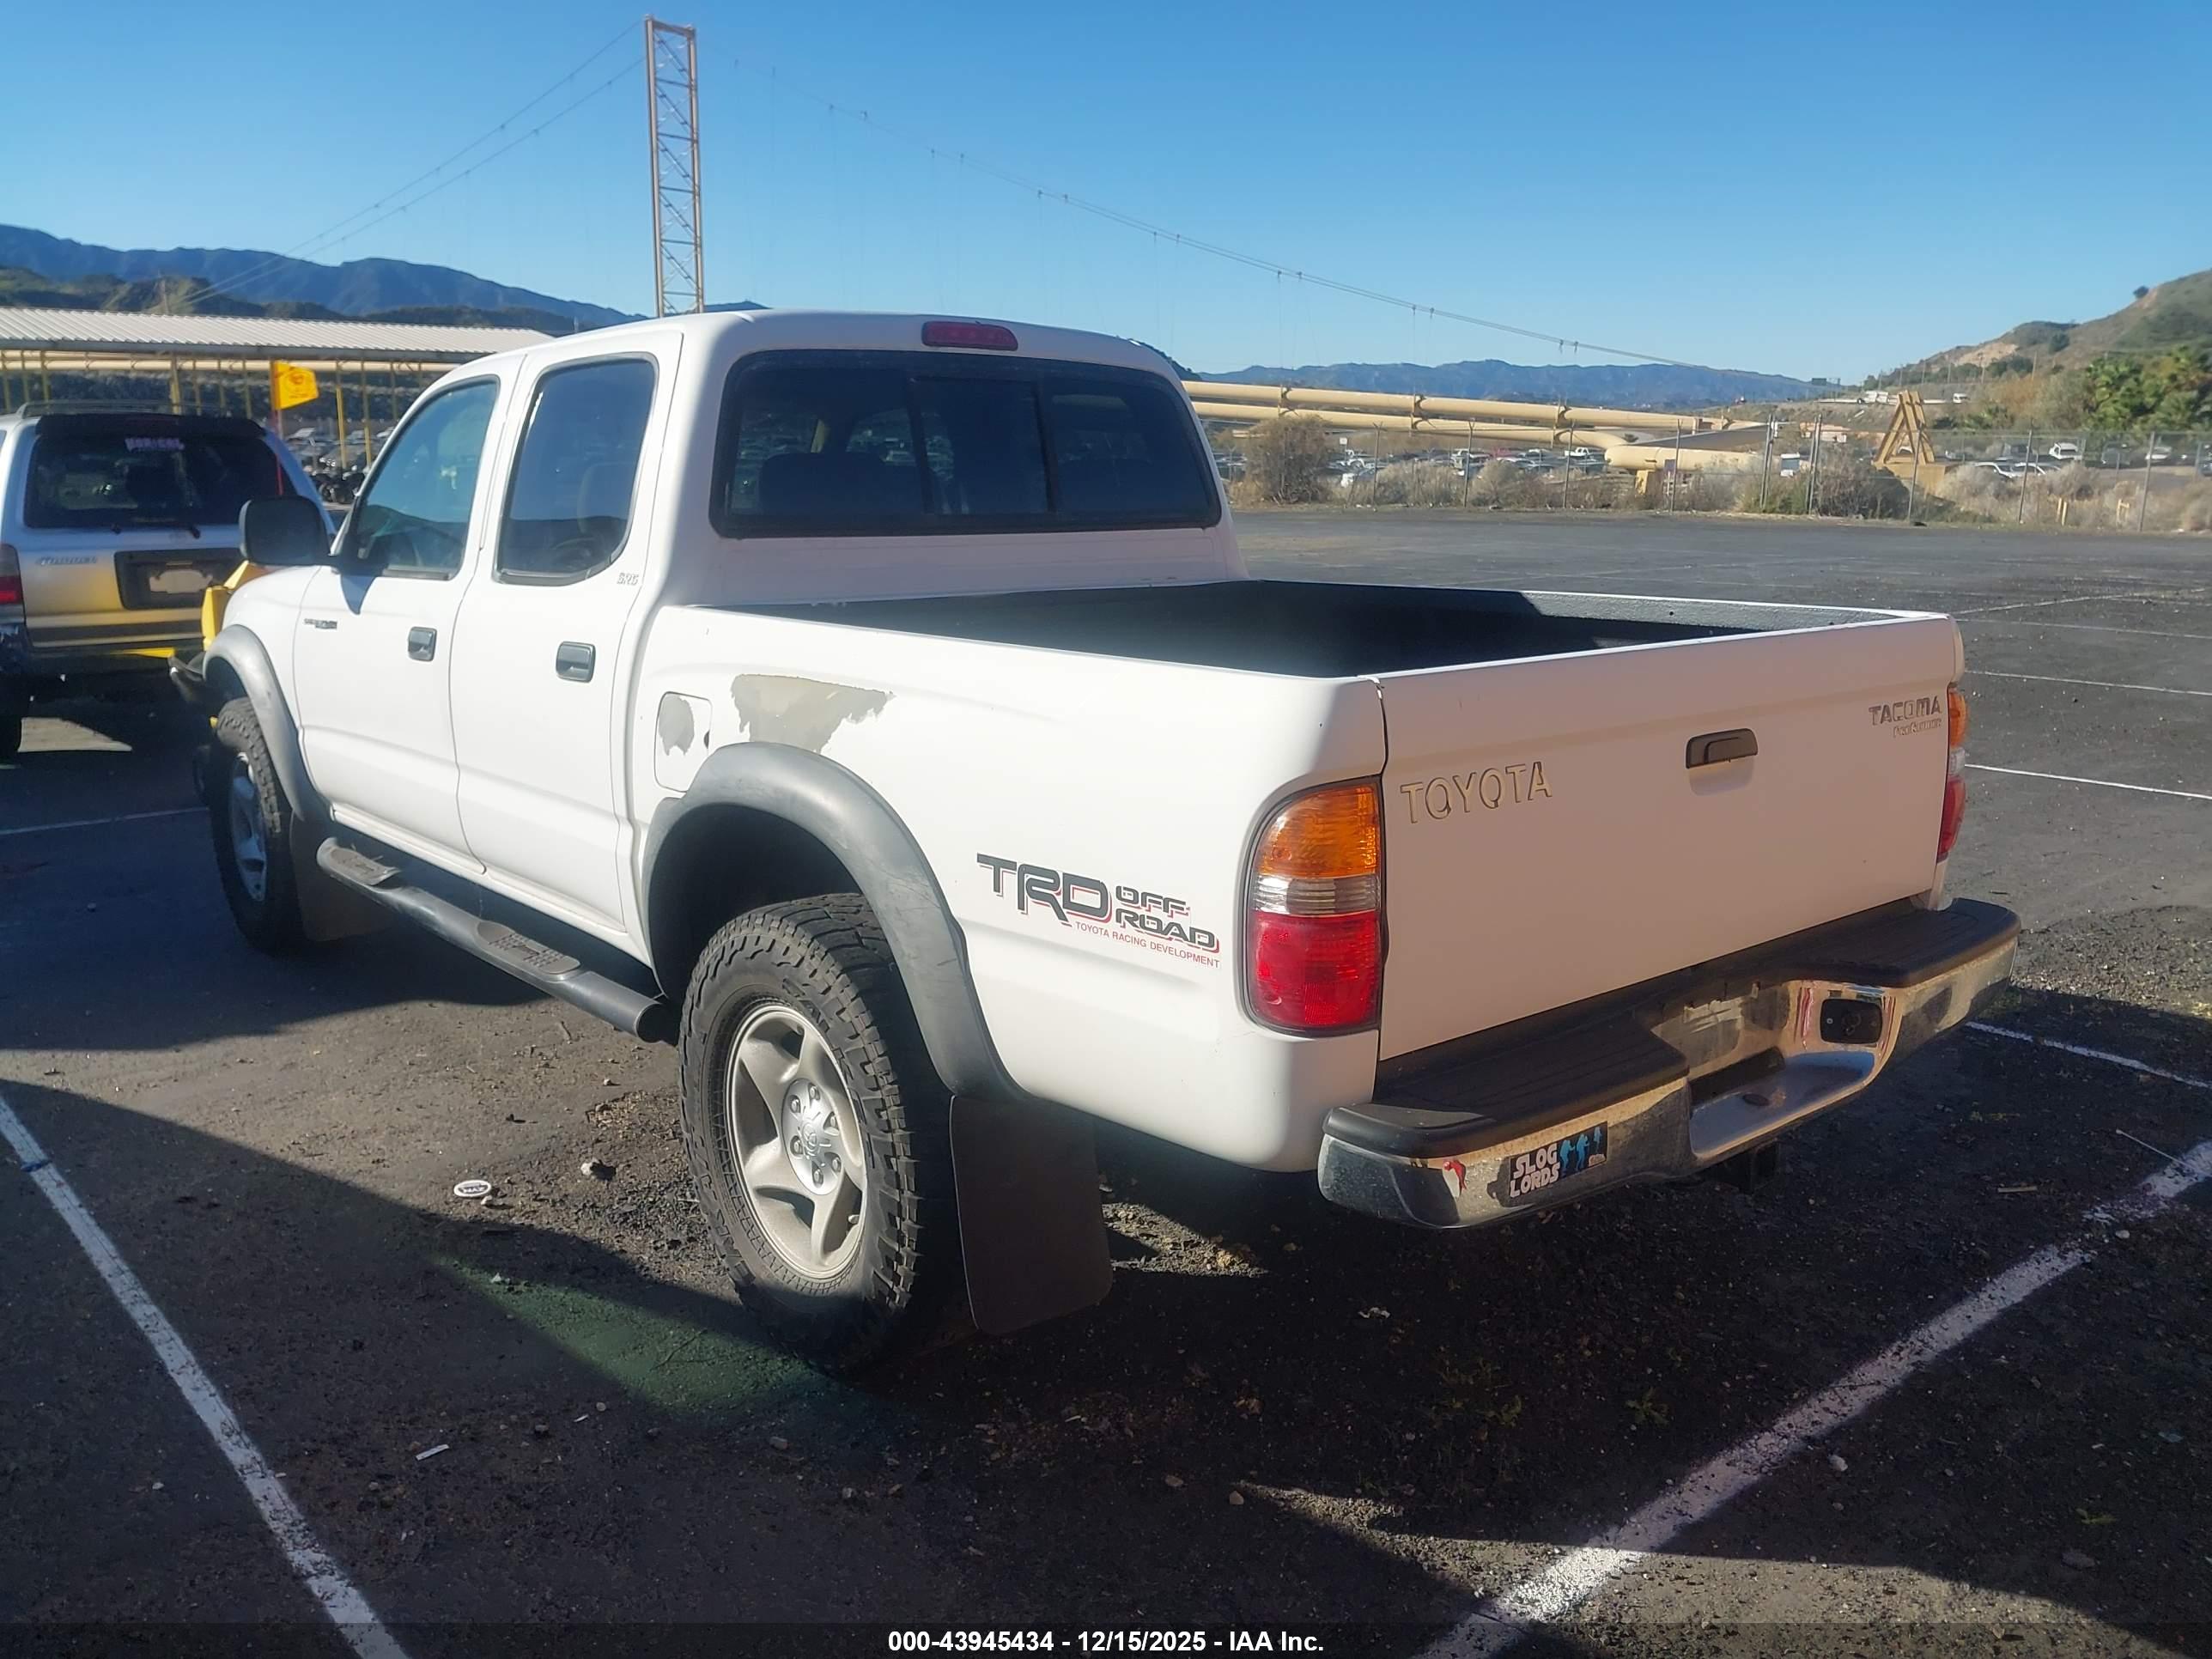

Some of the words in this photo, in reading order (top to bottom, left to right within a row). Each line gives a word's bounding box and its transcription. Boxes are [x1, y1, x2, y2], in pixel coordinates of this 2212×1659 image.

[1868, 696, 1942, 726] TACOMA
[1400, 762, 1553, 823] TOYOTA
[976, 853, 1112, 927] TRD
[1115, 885, 1190, 918] OFF
[1075, 921, 1110, 939] TOYOTA
[1112, 929, 1147, 948] RACING
[1150, 940, 1220, 969] DEVELOPMENT
[1115, 908, 1219, 953] ROAD
[1510, 1162, 1560, 1198] LORDS
[1512, 1143, 1559, 1179] SLOG
